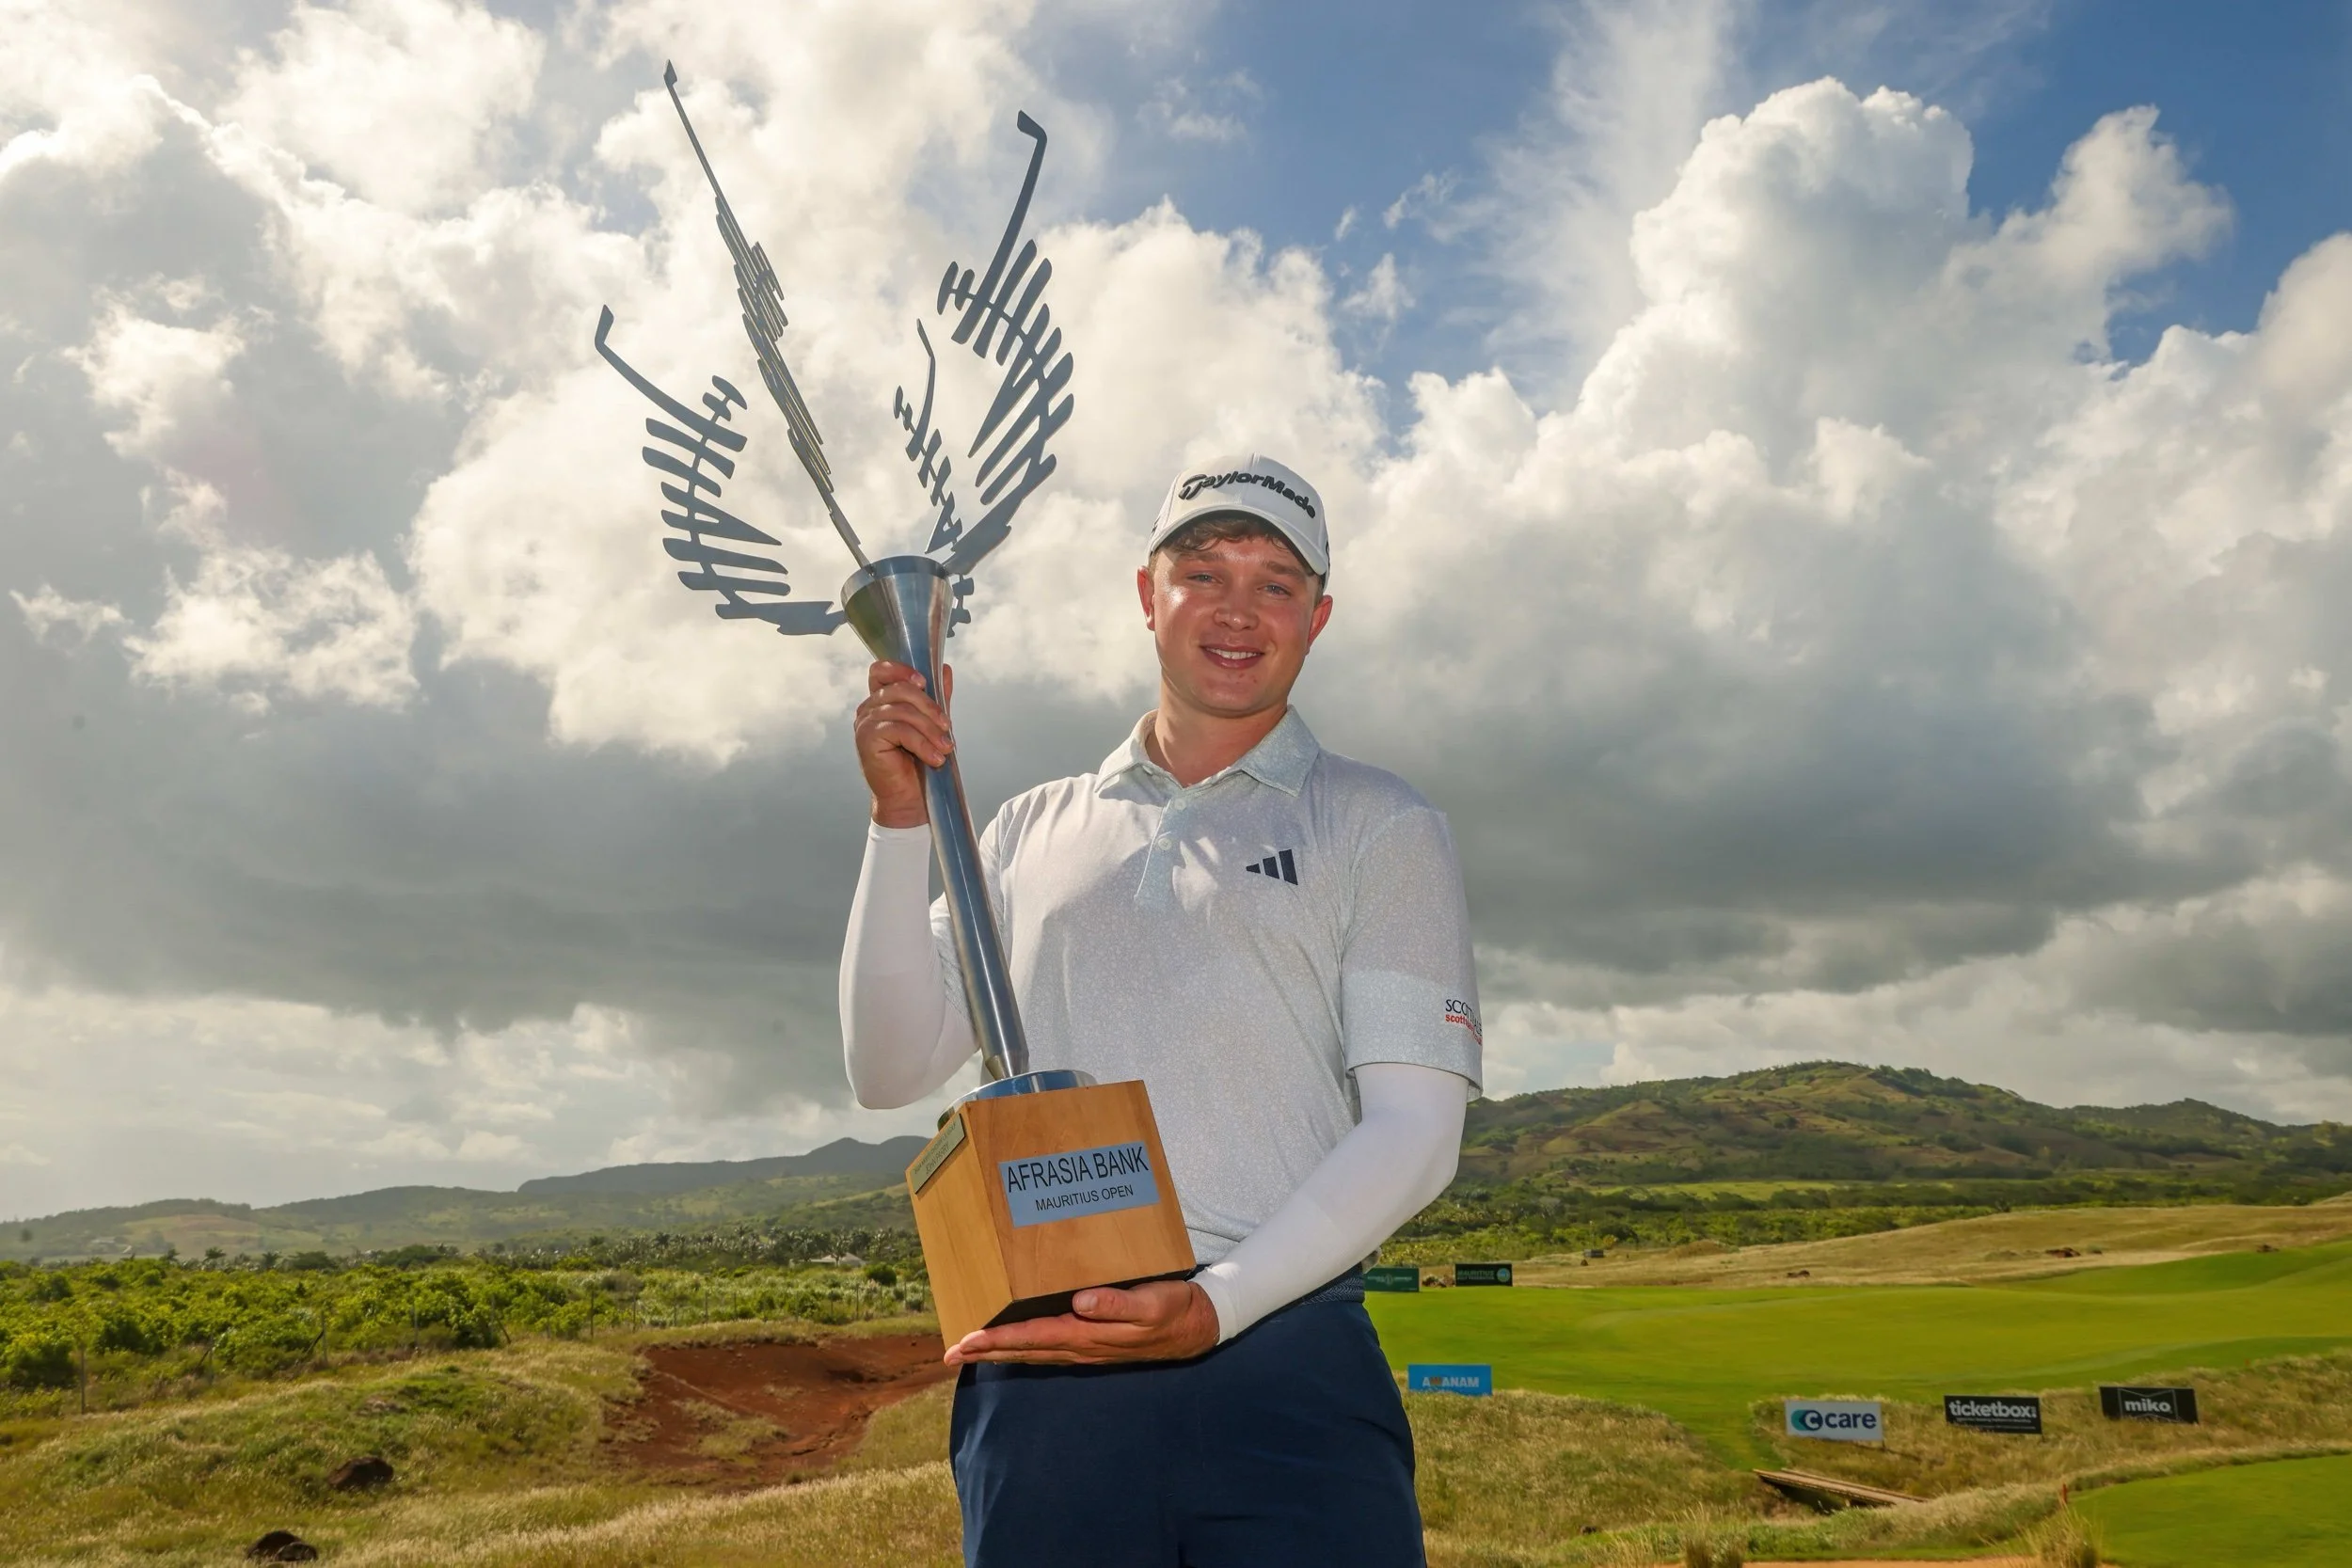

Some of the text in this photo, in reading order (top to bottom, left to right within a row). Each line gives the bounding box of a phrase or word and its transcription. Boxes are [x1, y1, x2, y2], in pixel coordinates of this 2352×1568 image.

[1179, 470, 1316, 518] TaylorMade
[1008, 1146, 1149, 1194] AFRASIA BANK
[1035, 1184, 1135, 1212] MAURITIUS OPEN
[2124, 1398, 2171, 1413] miko
[1824, 1412, 1877, 1429] care
